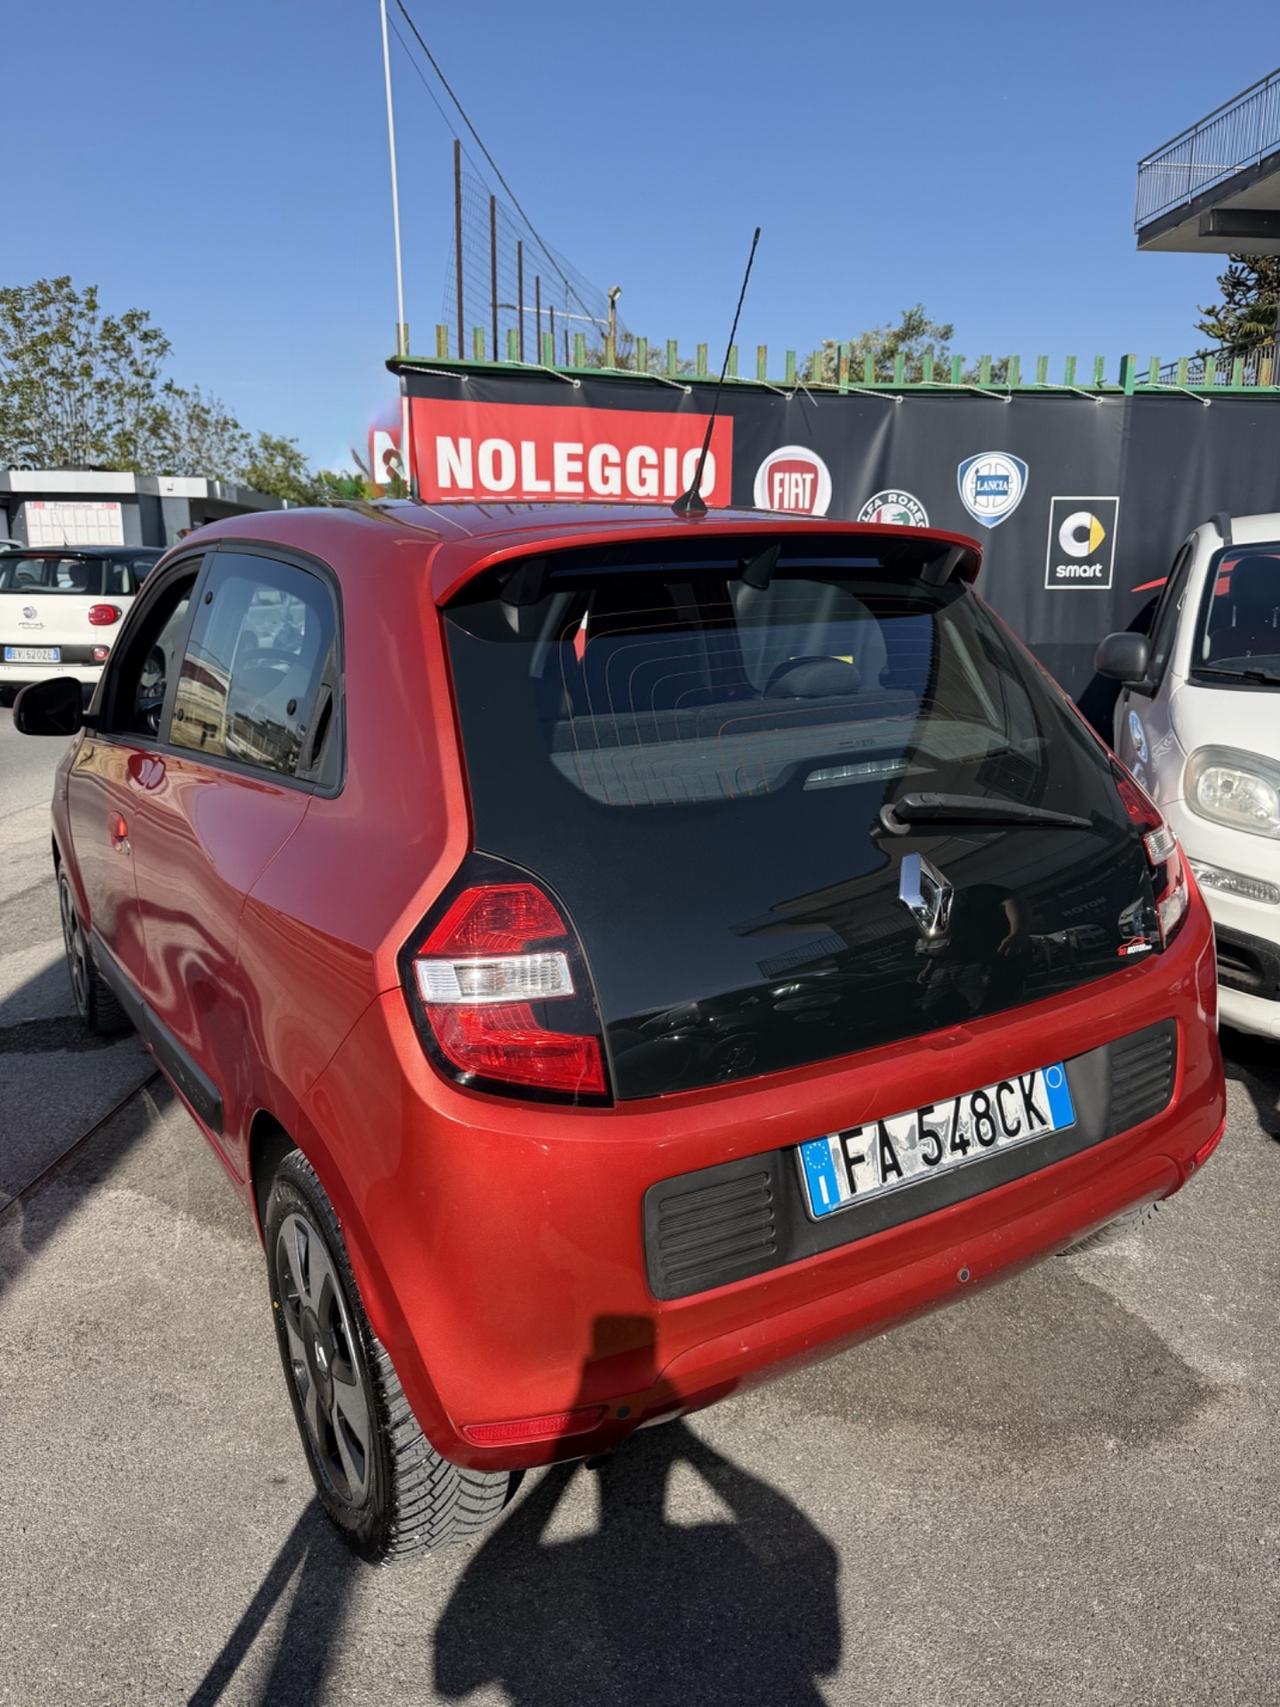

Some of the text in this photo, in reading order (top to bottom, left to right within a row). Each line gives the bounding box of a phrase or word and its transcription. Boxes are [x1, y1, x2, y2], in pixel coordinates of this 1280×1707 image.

[436, 435, 716, 498] NOLEGGIO
[773, 472, 815, 510] FIAT
[976, 480, 1009, 491] LANCIA
[861, 498, 883, 522] LFA
[1056, 563, 1102, 578] smart
[838, 1070, 1048, 1194] FA 548CK
